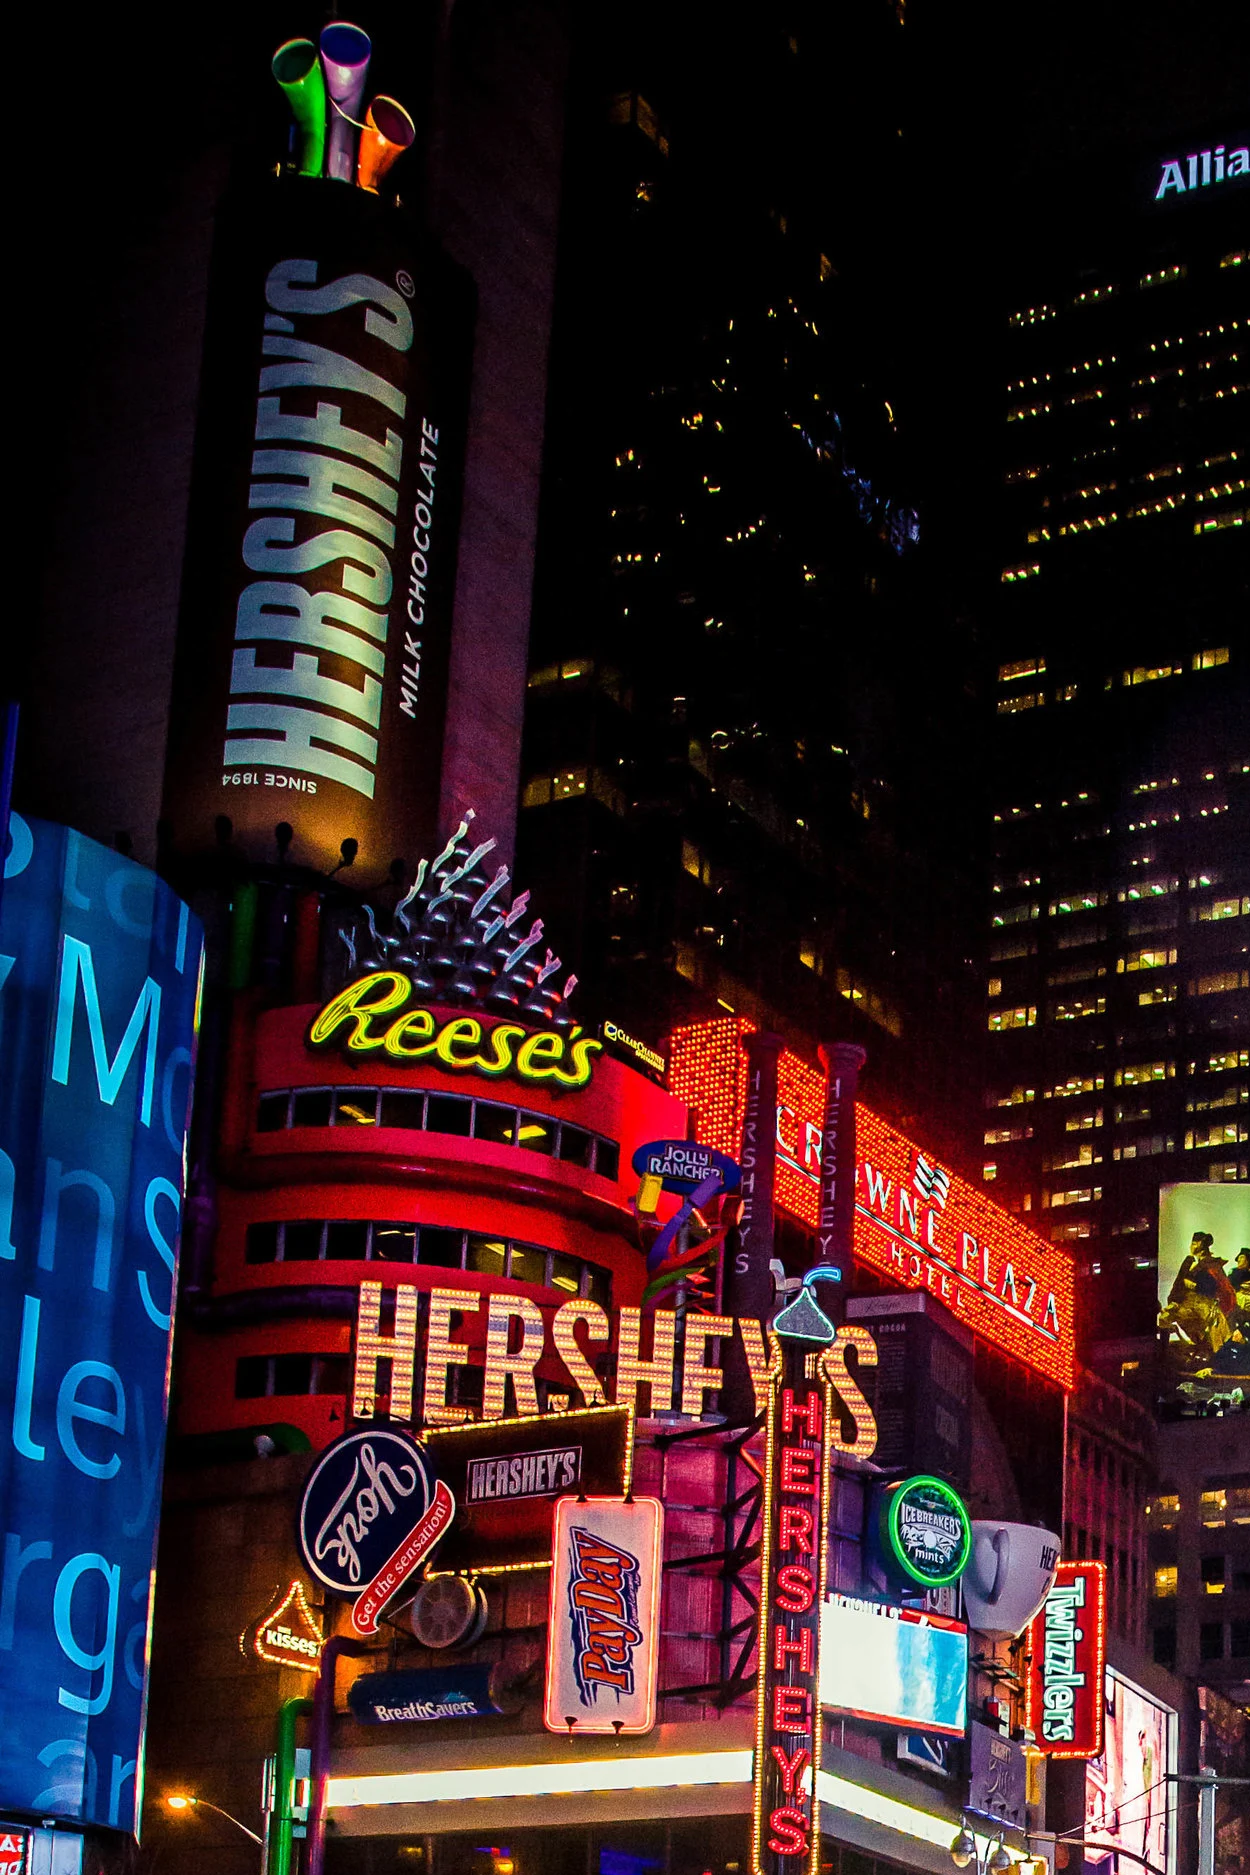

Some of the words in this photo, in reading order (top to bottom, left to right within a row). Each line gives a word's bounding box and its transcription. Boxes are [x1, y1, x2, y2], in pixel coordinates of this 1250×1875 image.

[223, 258, 415, 800] HERSHEY'S
[409, 416, 441, 626] CHOCOLATE
[399, 636, 425, 719] MILK
[222, 771, 259, 788] 1894
[263, 773, 318, 795] SINCE
[309, 970, 604, 1087] Reese's
[663, 1145, 710, 1166] JOLLY
[776, 1104, 945, 1255] CRWNE
[961, 1231, 1060, 1334] PLAZA
[891, 1242, 967, 1308] HOTEL
[315, 1442, 418, 1583] York
[472, 1450, 578, 1499] HERSHEY'S
[356, 1598, 377, 1629] Get
[374, 1570, 398, 1598] the
[393, 1499, 448, 1575] sensation!
[572, 1526, 641, 1697] PayDay
[914, 1547, 945, 1565] mints
[768, 1388, 821, 1857] HERSHEY'S
[1044, 1576, 1086, 1746] Twizzlers
[374, 1698, 478, 1722] BreathSavers
